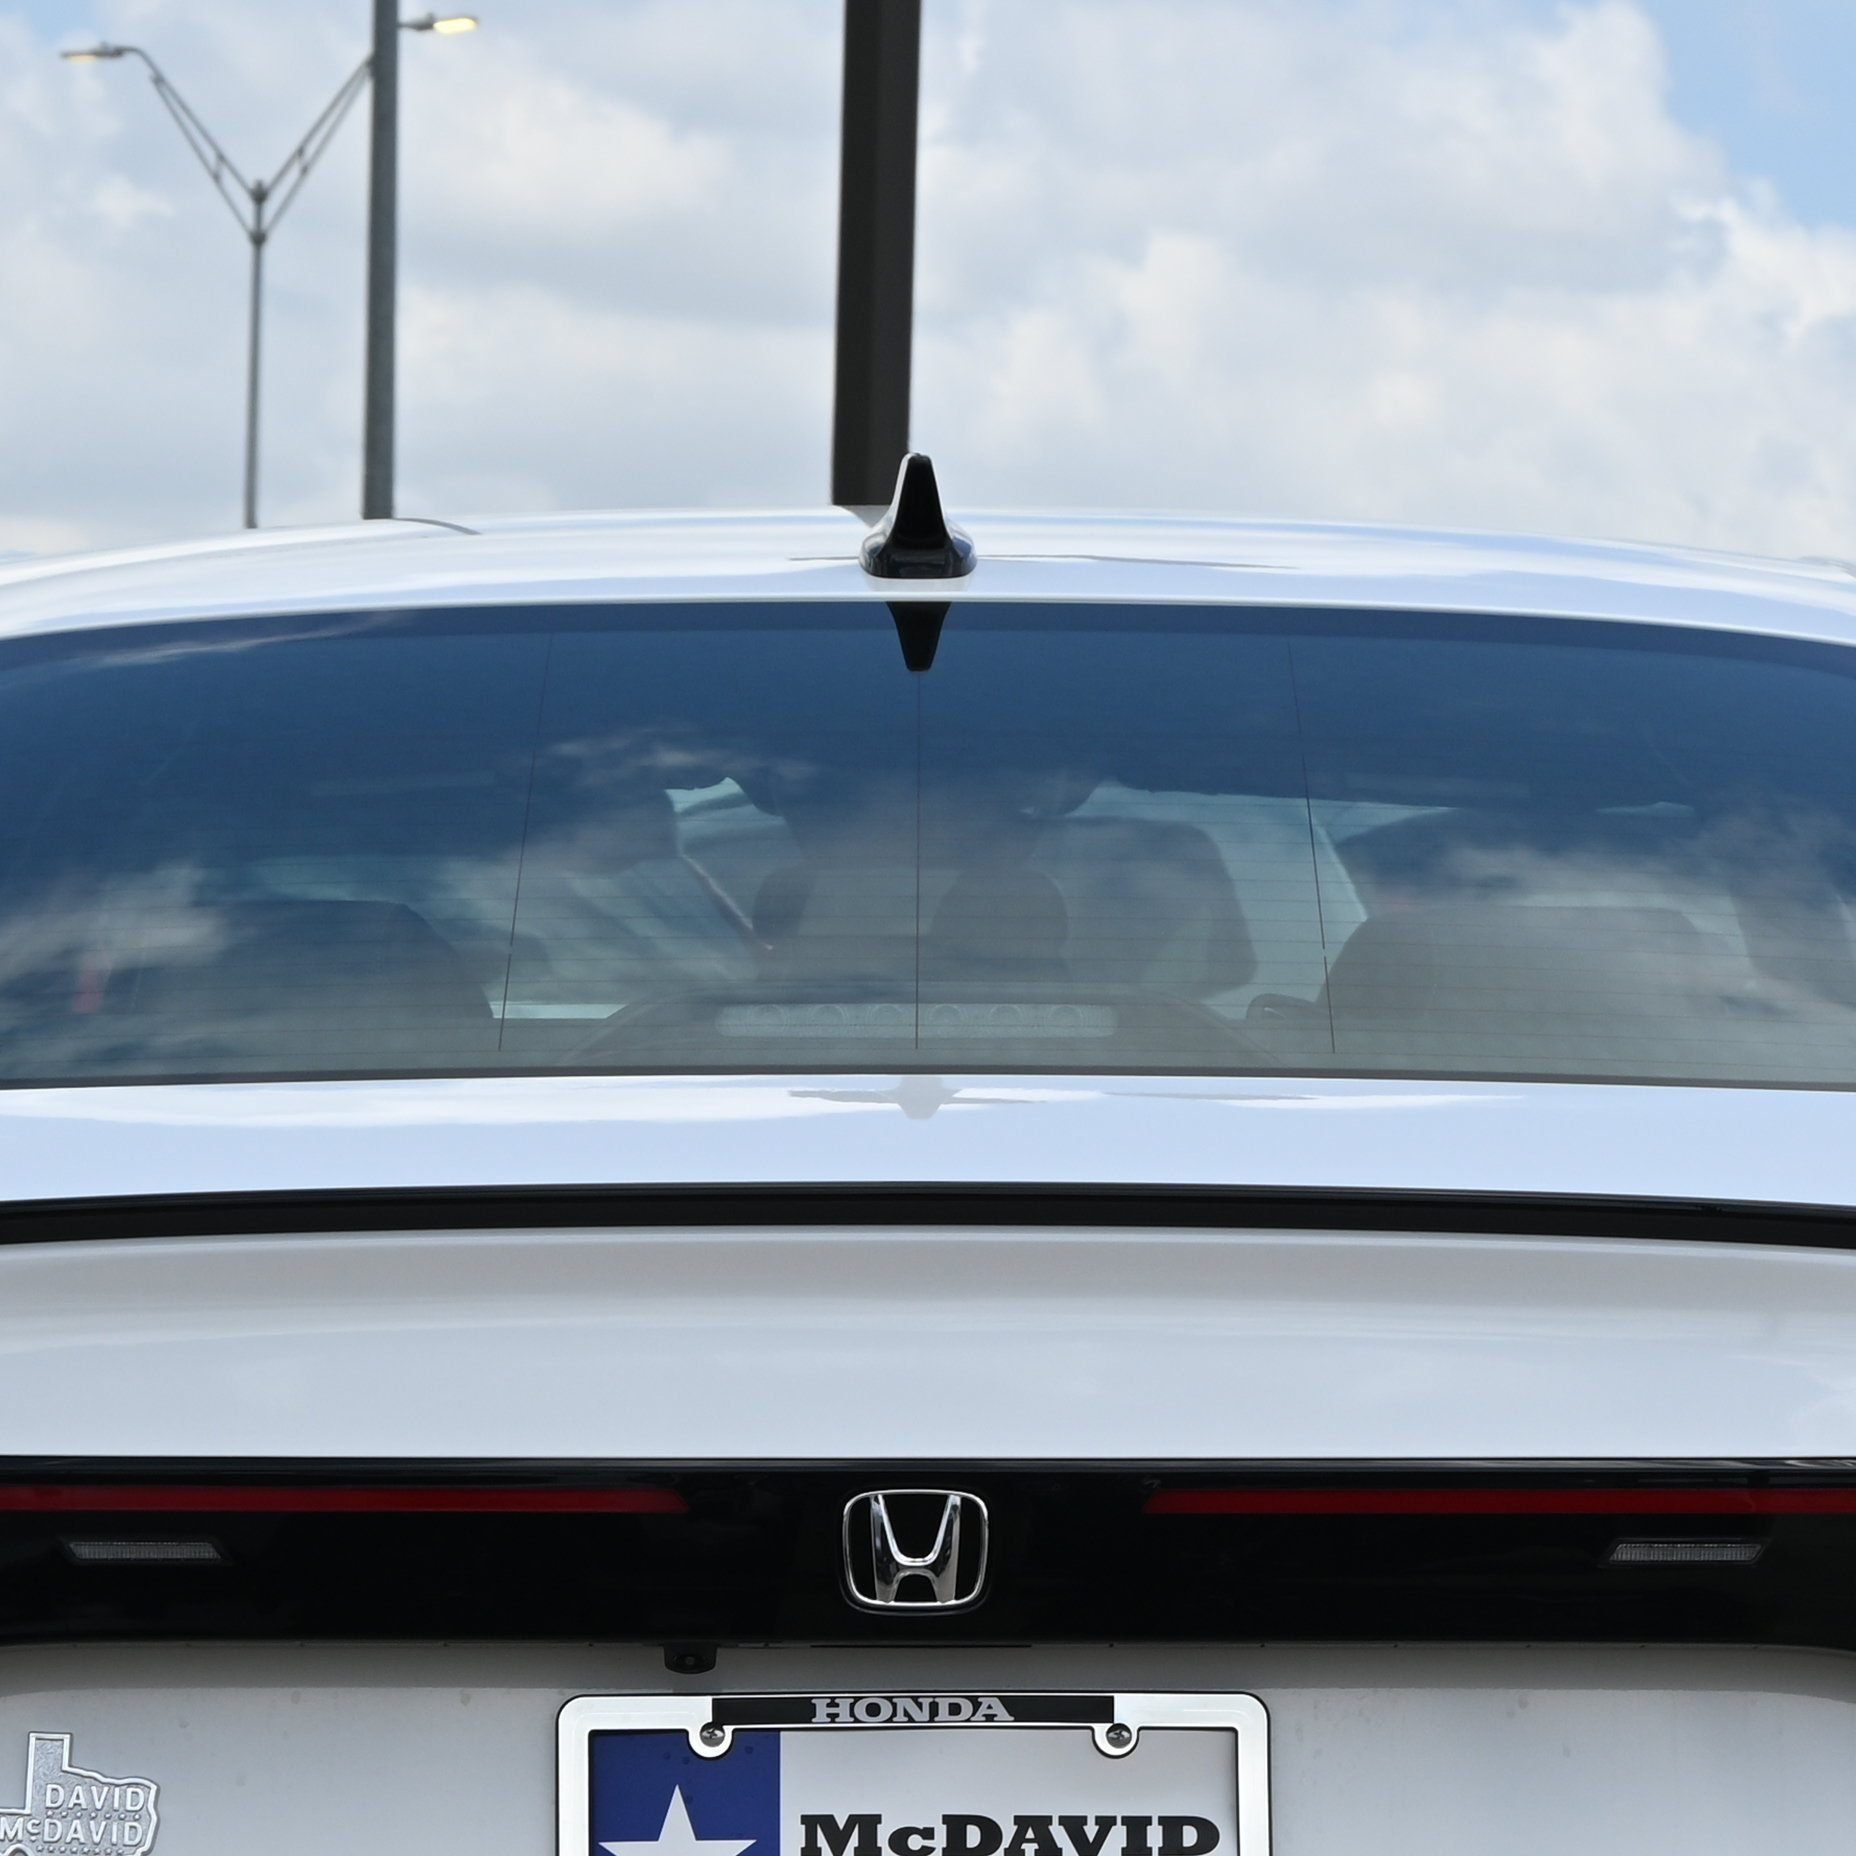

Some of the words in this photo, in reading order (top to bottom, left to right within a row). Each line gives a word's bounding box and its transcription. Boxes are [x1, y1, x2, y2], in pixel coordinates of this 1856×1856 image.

[811, 1696, 1015, 1723] HONDA
[45, 1784, 144, 1812] DAVID
[0, 1816, 143, 1847] McDAVID
